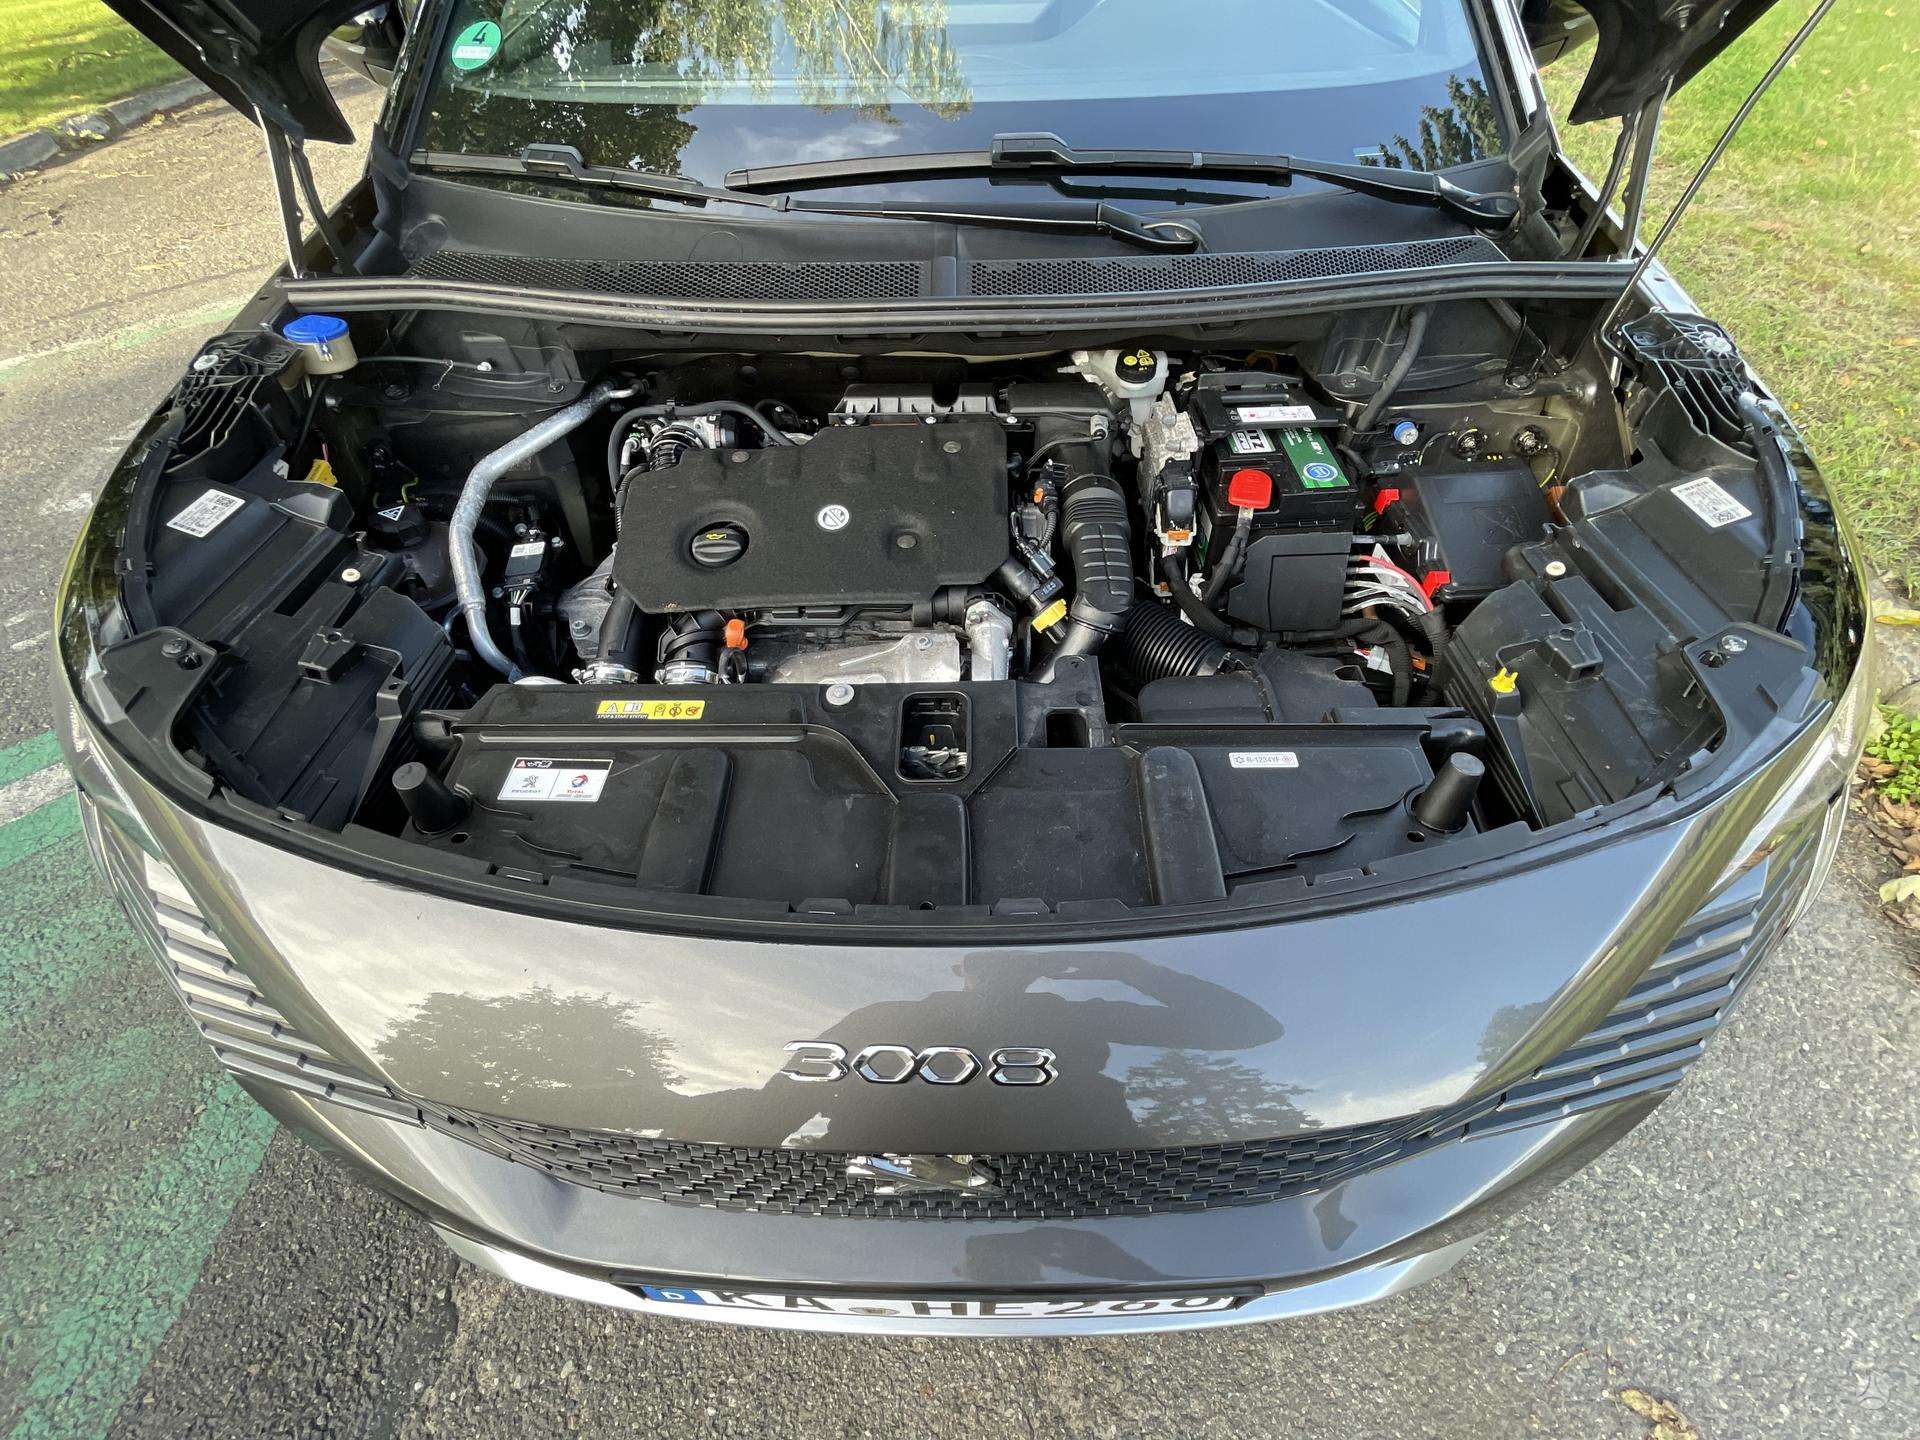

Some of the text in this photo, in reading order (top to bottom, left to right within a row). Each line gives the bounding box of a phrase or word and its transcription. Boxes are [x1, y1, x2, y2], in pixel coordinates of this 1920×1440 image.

[472, 22, 489, 44] 4
[780, 1040, 1059, 1087] 3008
[660, 1290, 685, 1301] D
